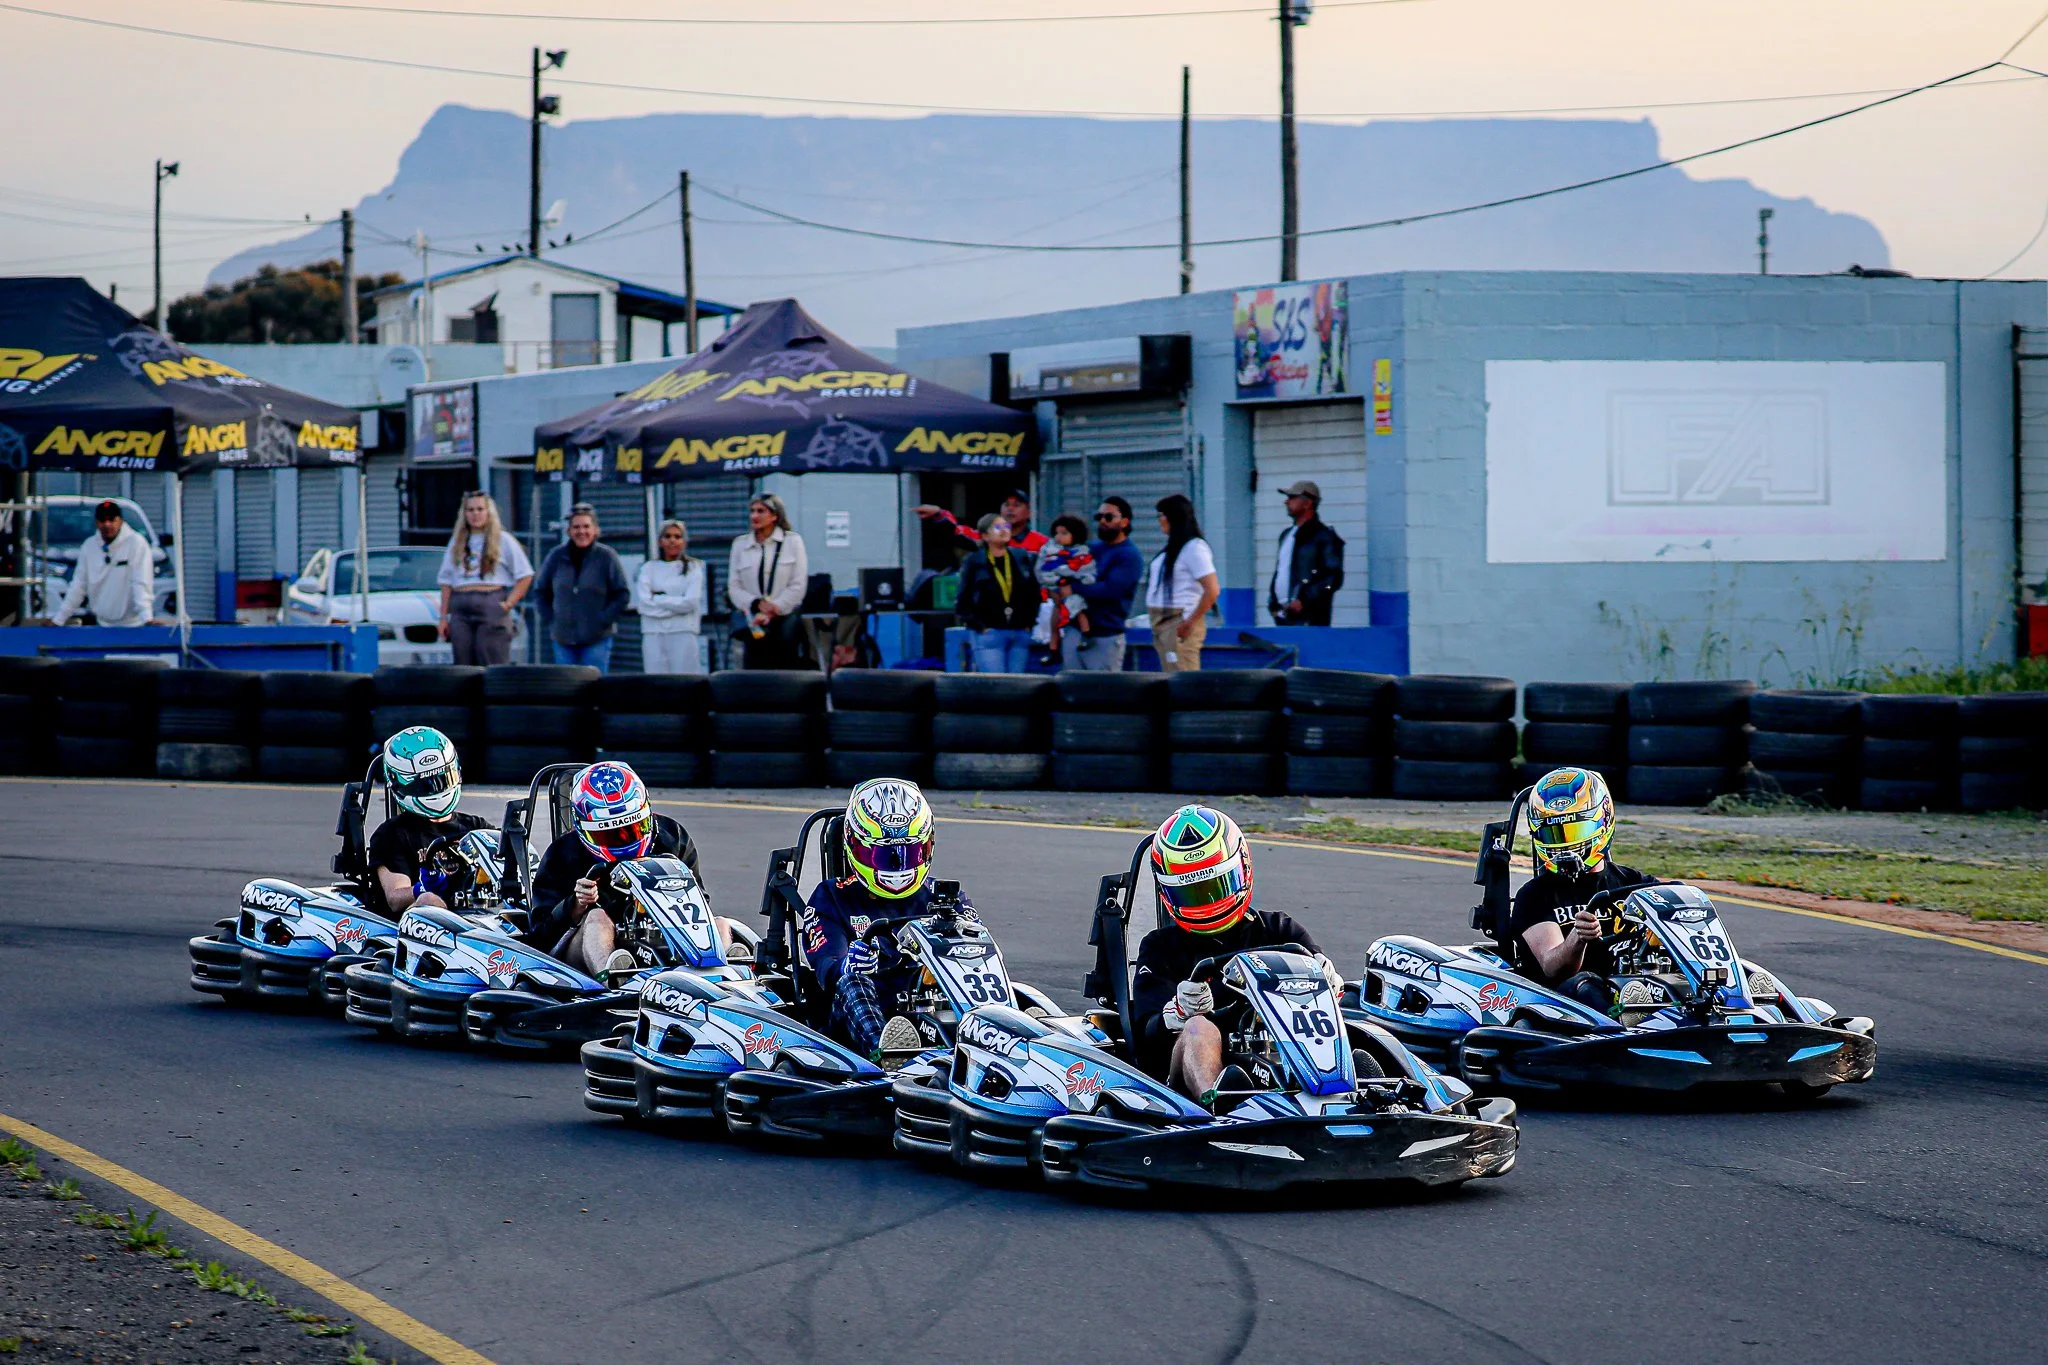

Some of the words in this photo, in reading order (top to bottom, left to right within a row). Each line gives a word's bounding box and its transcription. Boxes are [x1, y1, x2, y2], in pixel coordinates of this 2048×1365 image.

[716, 371, 907, 401] ANGRI
[819, 387, 904, 398] RACING
[32, 425, 167, 457] ANGRI
[183, 420, 247, 456] ANGRI
[655, 431, 787, 468] ANGRI
[894, 427, 1025, 456] ANGRI
[98, 456, 156, 470] RACING
[723, 455, 781, 471] RACING
[961, 453, 1017, 468] RACING
[612, 812, 642, 826] RACING
[881, 814, 907, 824] Arai
[654, 879, 688, 889] ANGRI
[243, 885, 296, 911] ANGRI
[668, 902, 708, 925] 12
[1670, 909, 1708, 921] ANGRI
[335, 918, 369, 943] Sodi
[399, 914, 445, 945] ANGRI
[946, 945, 986, 956] ANGRI
[1369, 942, 1434, 978] ANGRI
[1689, 935, 1731, 961] 63
[487, 949, 520, 977] Sodi
[641, 979, 702, 1016] ANGRI
[963, 973, 1008, 1003] 33
[1274, 980, 1320, 991] ANGRI
[1478, 982, 1519, 1011] Sodi
[919, 1020, 937, 1040] ANGRI
[957, 1015, 1023, 1054] ANGRI
[1292, 1010, 1336, 1039] 46
[743, 1021, 782, 1055] Sodi
[1065, 1061, 1105, 1095] Sodi
[1252, 1062, 1271, 1083] ANGRI
